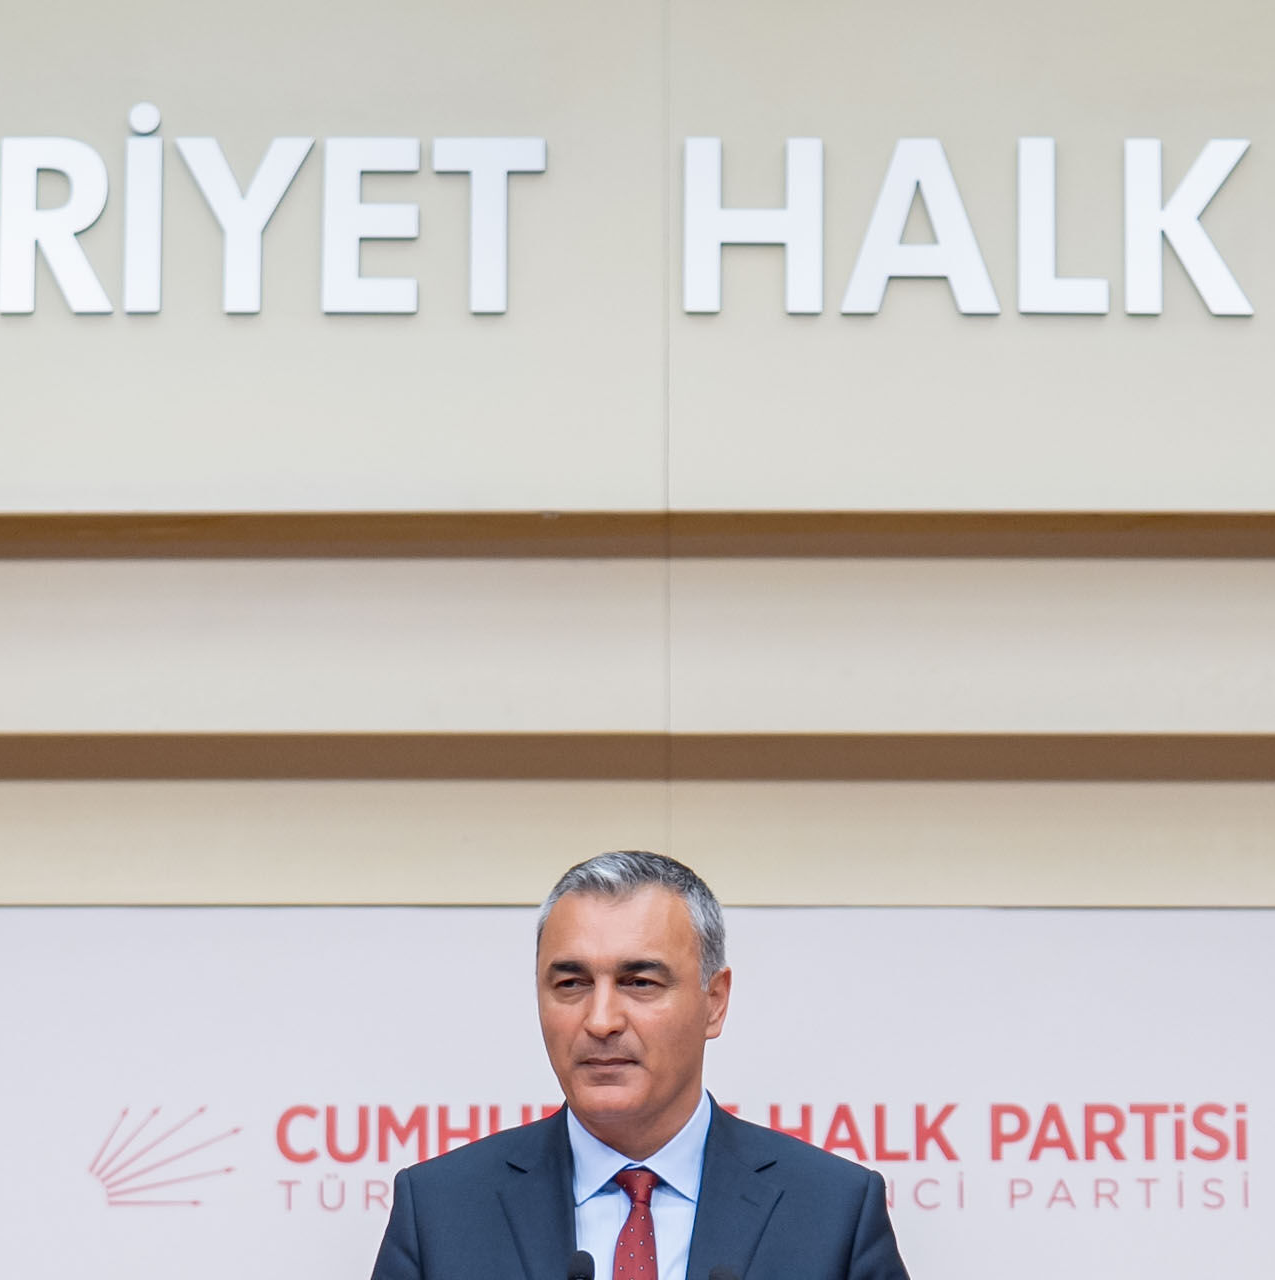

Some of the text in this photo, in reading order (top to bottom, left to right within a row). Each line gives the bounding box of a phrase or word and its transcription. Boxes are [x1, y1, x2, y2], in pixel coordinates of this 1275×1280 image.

[682, 135, 1254, 317] HALK
[769, 1104, 959, 1162] HALK
[1008, 1170, 1250, 1210] PARTİSİ
